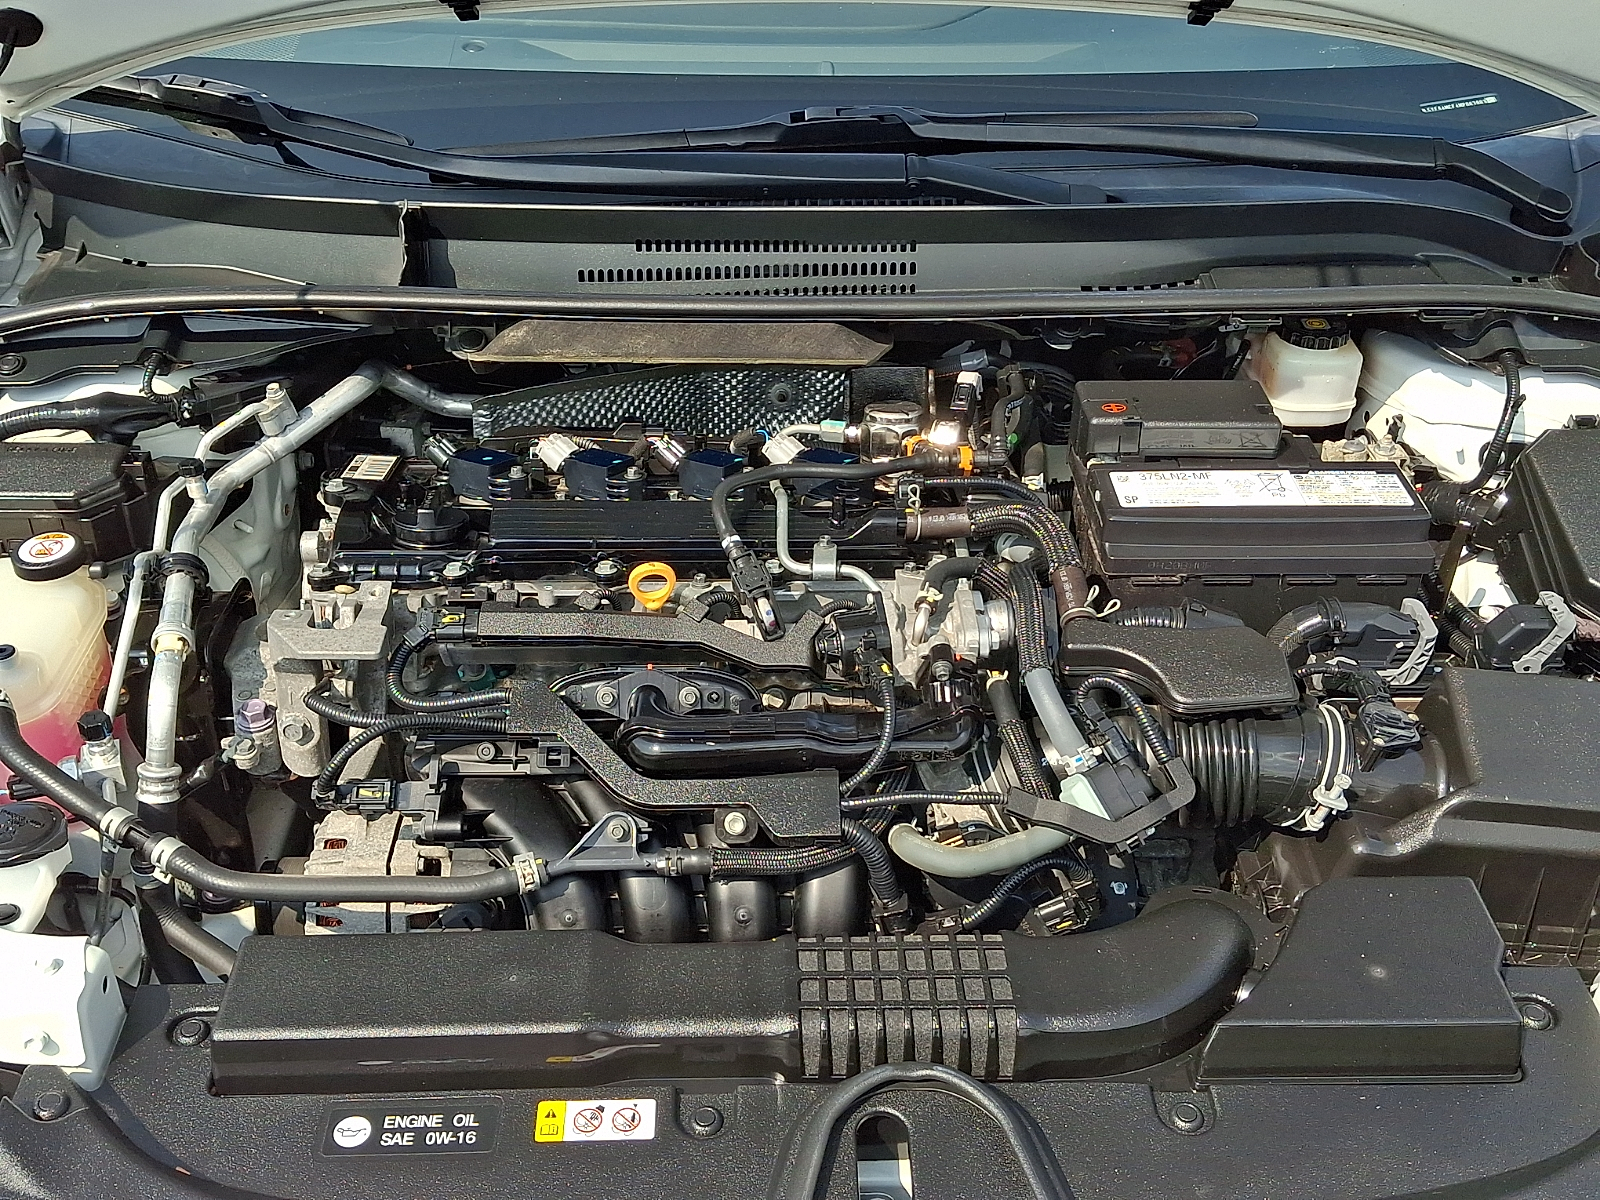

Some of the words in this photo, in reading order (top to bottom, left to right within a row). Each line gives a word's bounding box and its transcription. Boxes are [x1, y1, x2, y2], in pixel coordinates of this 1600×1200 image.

[1123, 495, 1139, 504] SP
[383, 1114, 444, 1129] ENGINE
[452, 1113, 480, 1128] OIL
[380, 1131, 416, 1147] SAE
[424, 1130, 478, 1146] 0W-16
